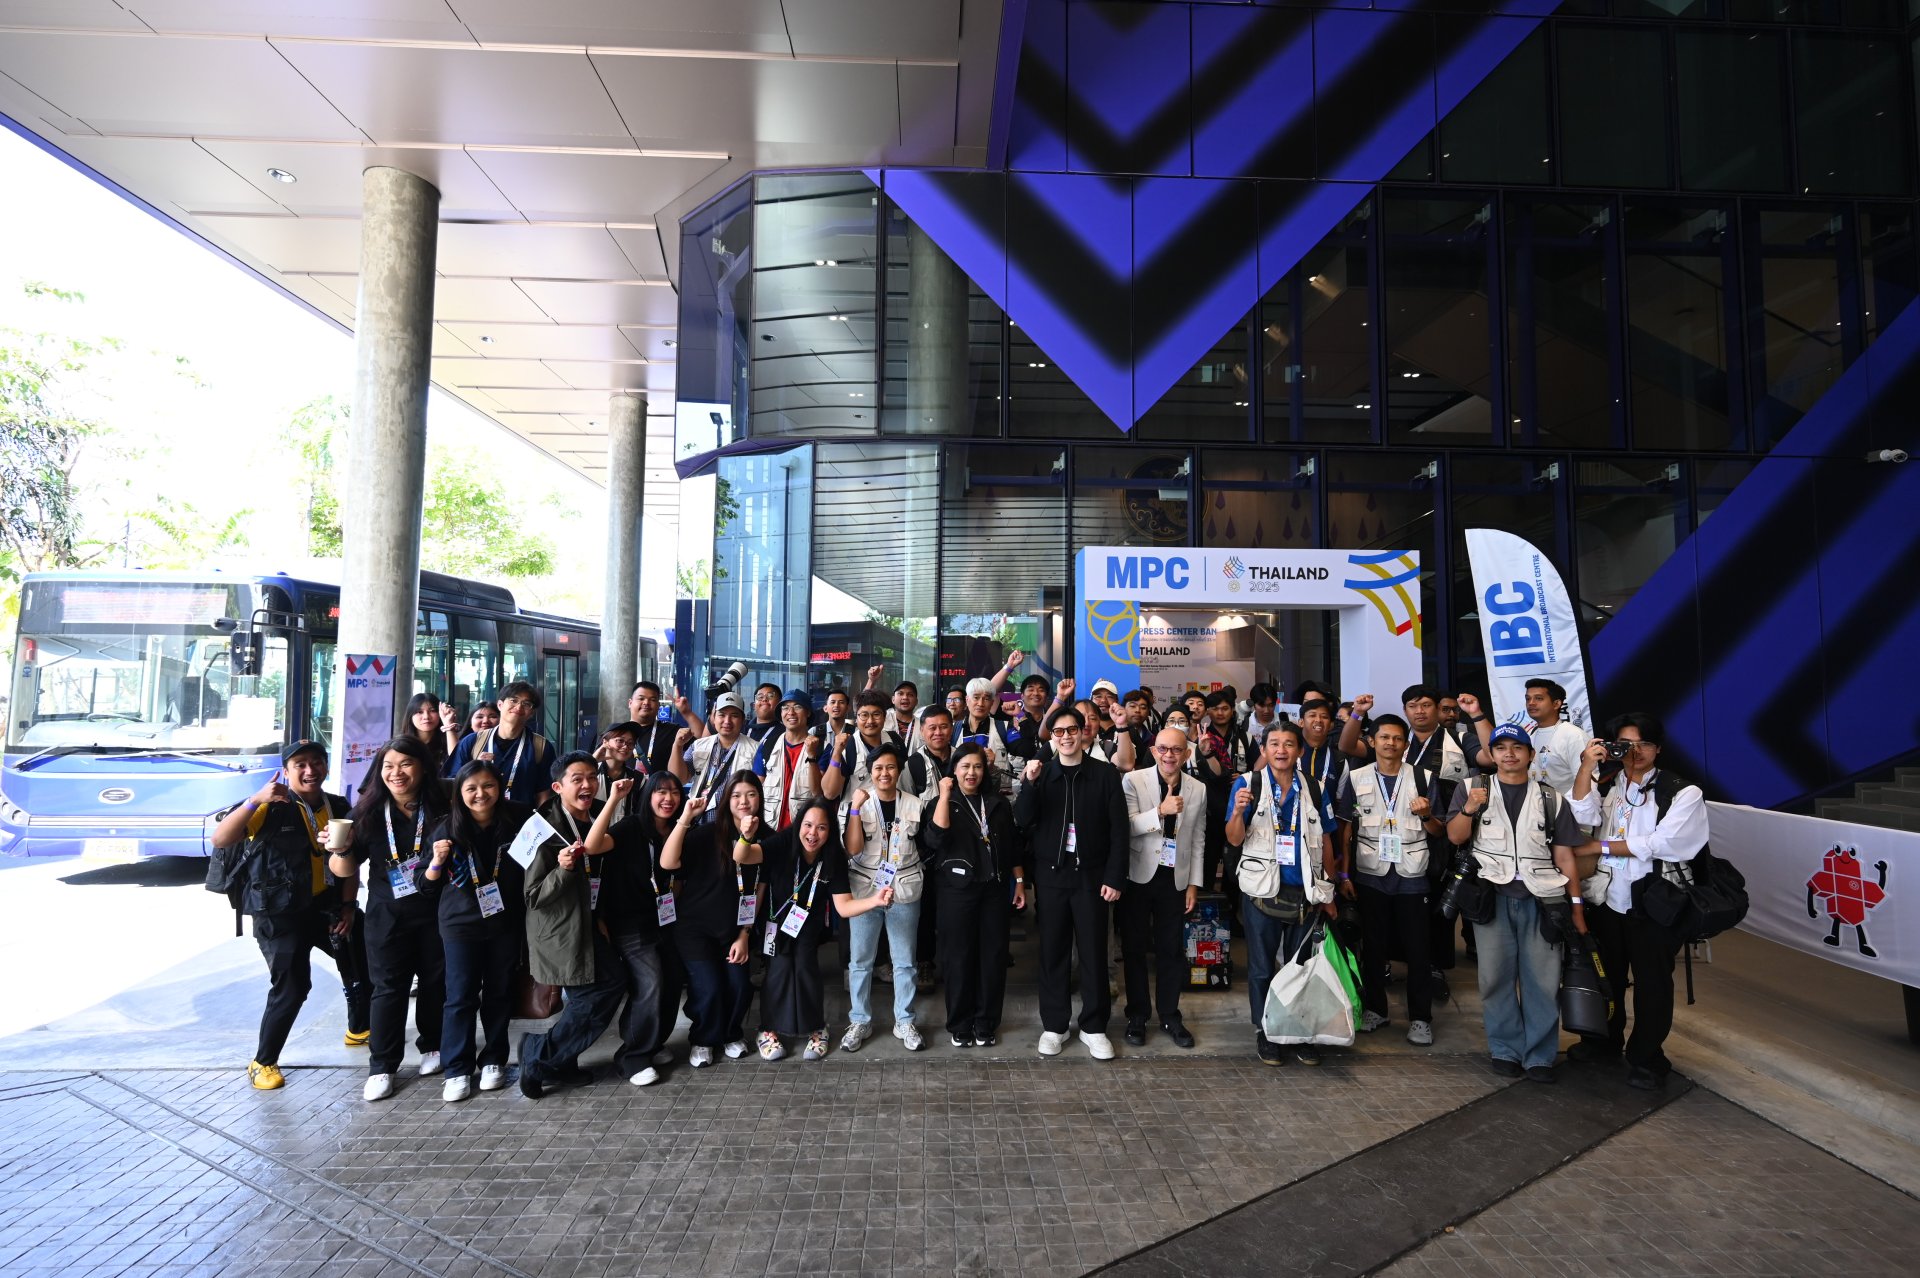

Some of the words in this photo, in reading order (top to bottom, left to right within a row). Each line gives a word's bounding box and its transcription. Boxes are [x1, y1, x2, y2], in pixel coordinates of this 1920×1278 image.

[1106, 556, 1190, 590] MPC
[1249, 566, 1329, 580] THAILAND
[1533, 554, 1542, 578] CENTRE
[1249, 581, 1280, 593] 2025
[1536, 579, 1548, 615] BROADCAST
[1139, 627, 1165, 635] PRESS
[1166, 627, 1198, 635] CENTER
[1484, 581, 1546, 667] IBC
[1543, 615, 1556, 663] INTERNATIONAL
[1139, 646, 1191, 656] THAILAND
[347, 678, 368, 689] MPC
